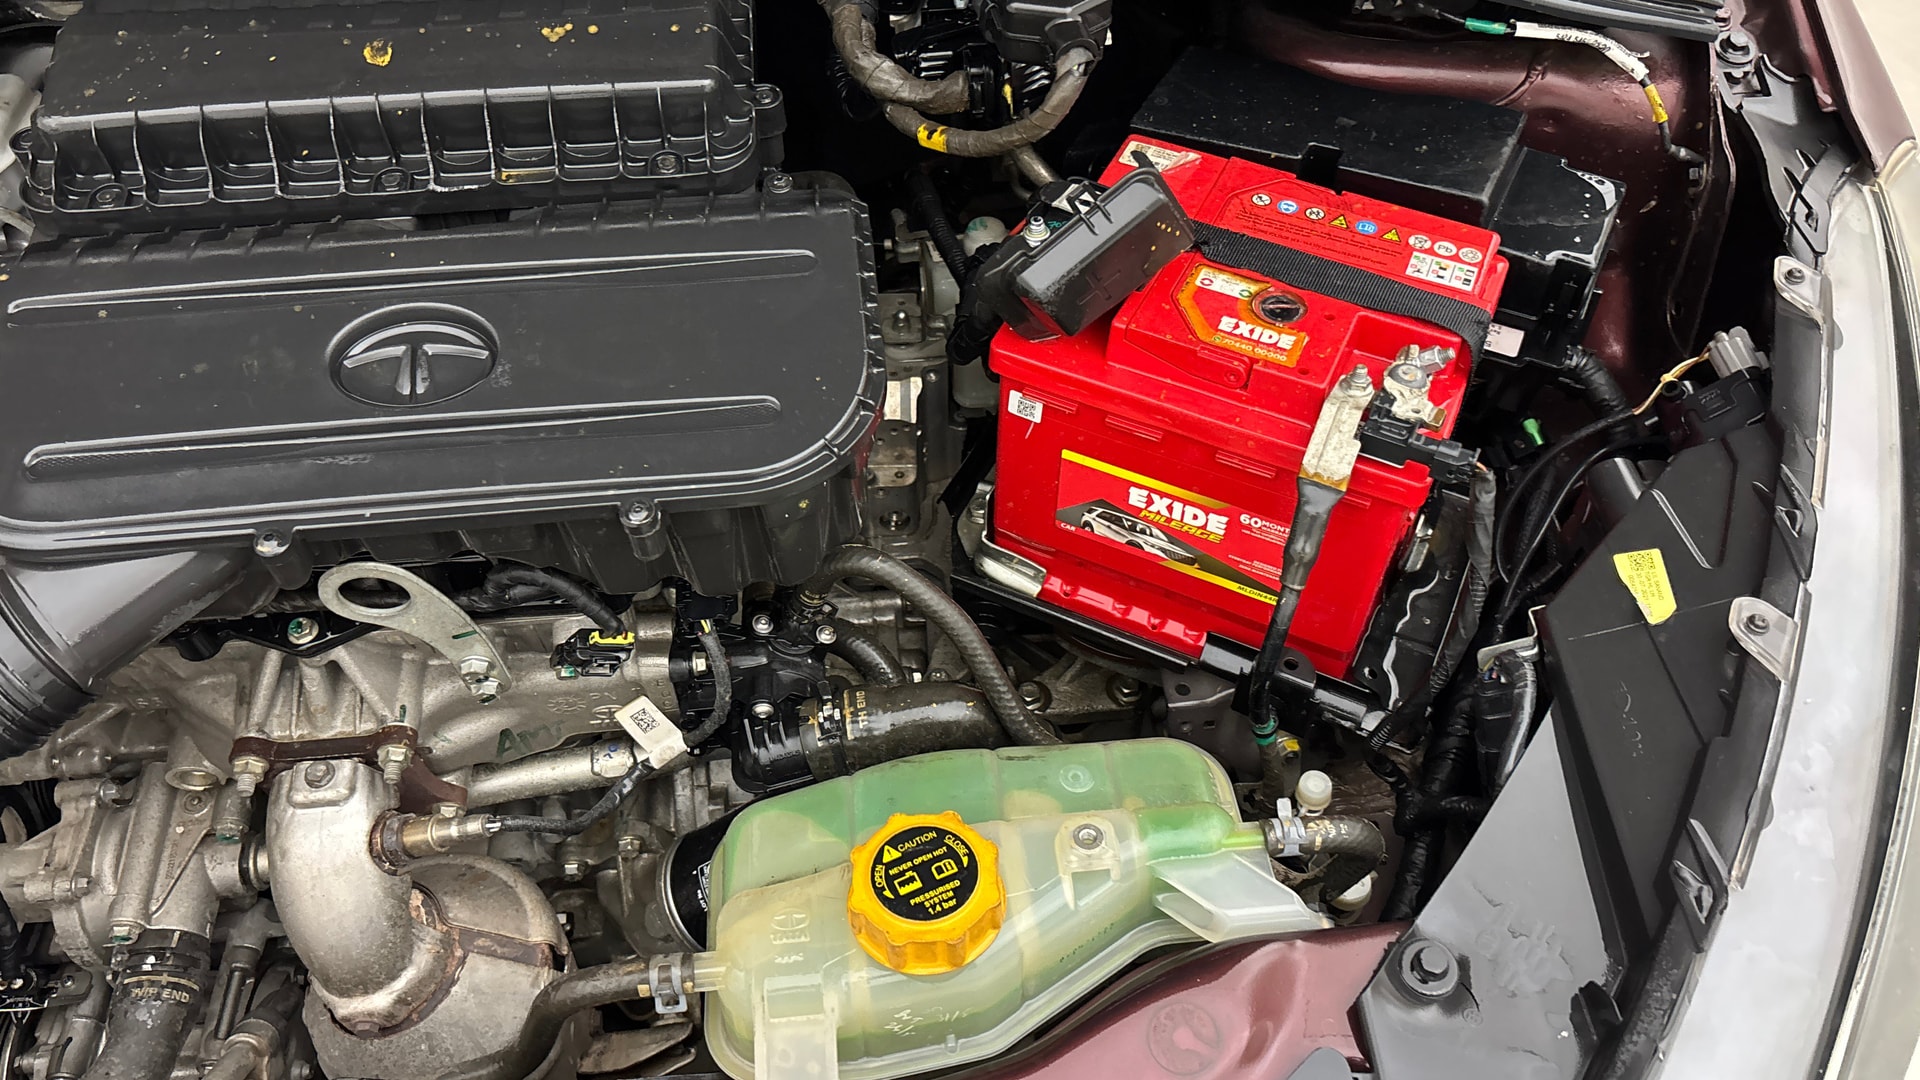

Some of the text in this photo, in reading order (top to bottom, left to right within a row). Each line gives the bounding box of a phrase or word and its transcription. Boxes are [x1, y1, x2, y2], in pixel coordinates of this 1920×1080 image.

[1437, 244, 1453, 254] Pb
[1217, 315, 1297, 350] EXIDE
[1222, 338, 1253, 352] 70440
[1254, 346, 1287, 361] 00000
[1128, 485, 1230, 535] EXIDE
[1060, 522, 1076, 532] CAR
[1139, 509, 1224, 544] MILEAGE
[1240, 513, 1290, 534] 60 MONT
[1261, 527, 1289, 538] WARRAN
[855, 690, 868, 729] TH END
[897, 830, 937, 852] CAUTION
[945, 834, 969, 857] CLOSE
[888, 846, 948, 876] NEVER OPEN HOT
[874, 864, 884, 888] OPEN
[909, 879, 961, 906] PRESSURISED
[924, 890, 954, 908] SYSTEM
[928, 898, 957, 915] 1.4 bar
[131, 986, 190, 1003] W/P END
